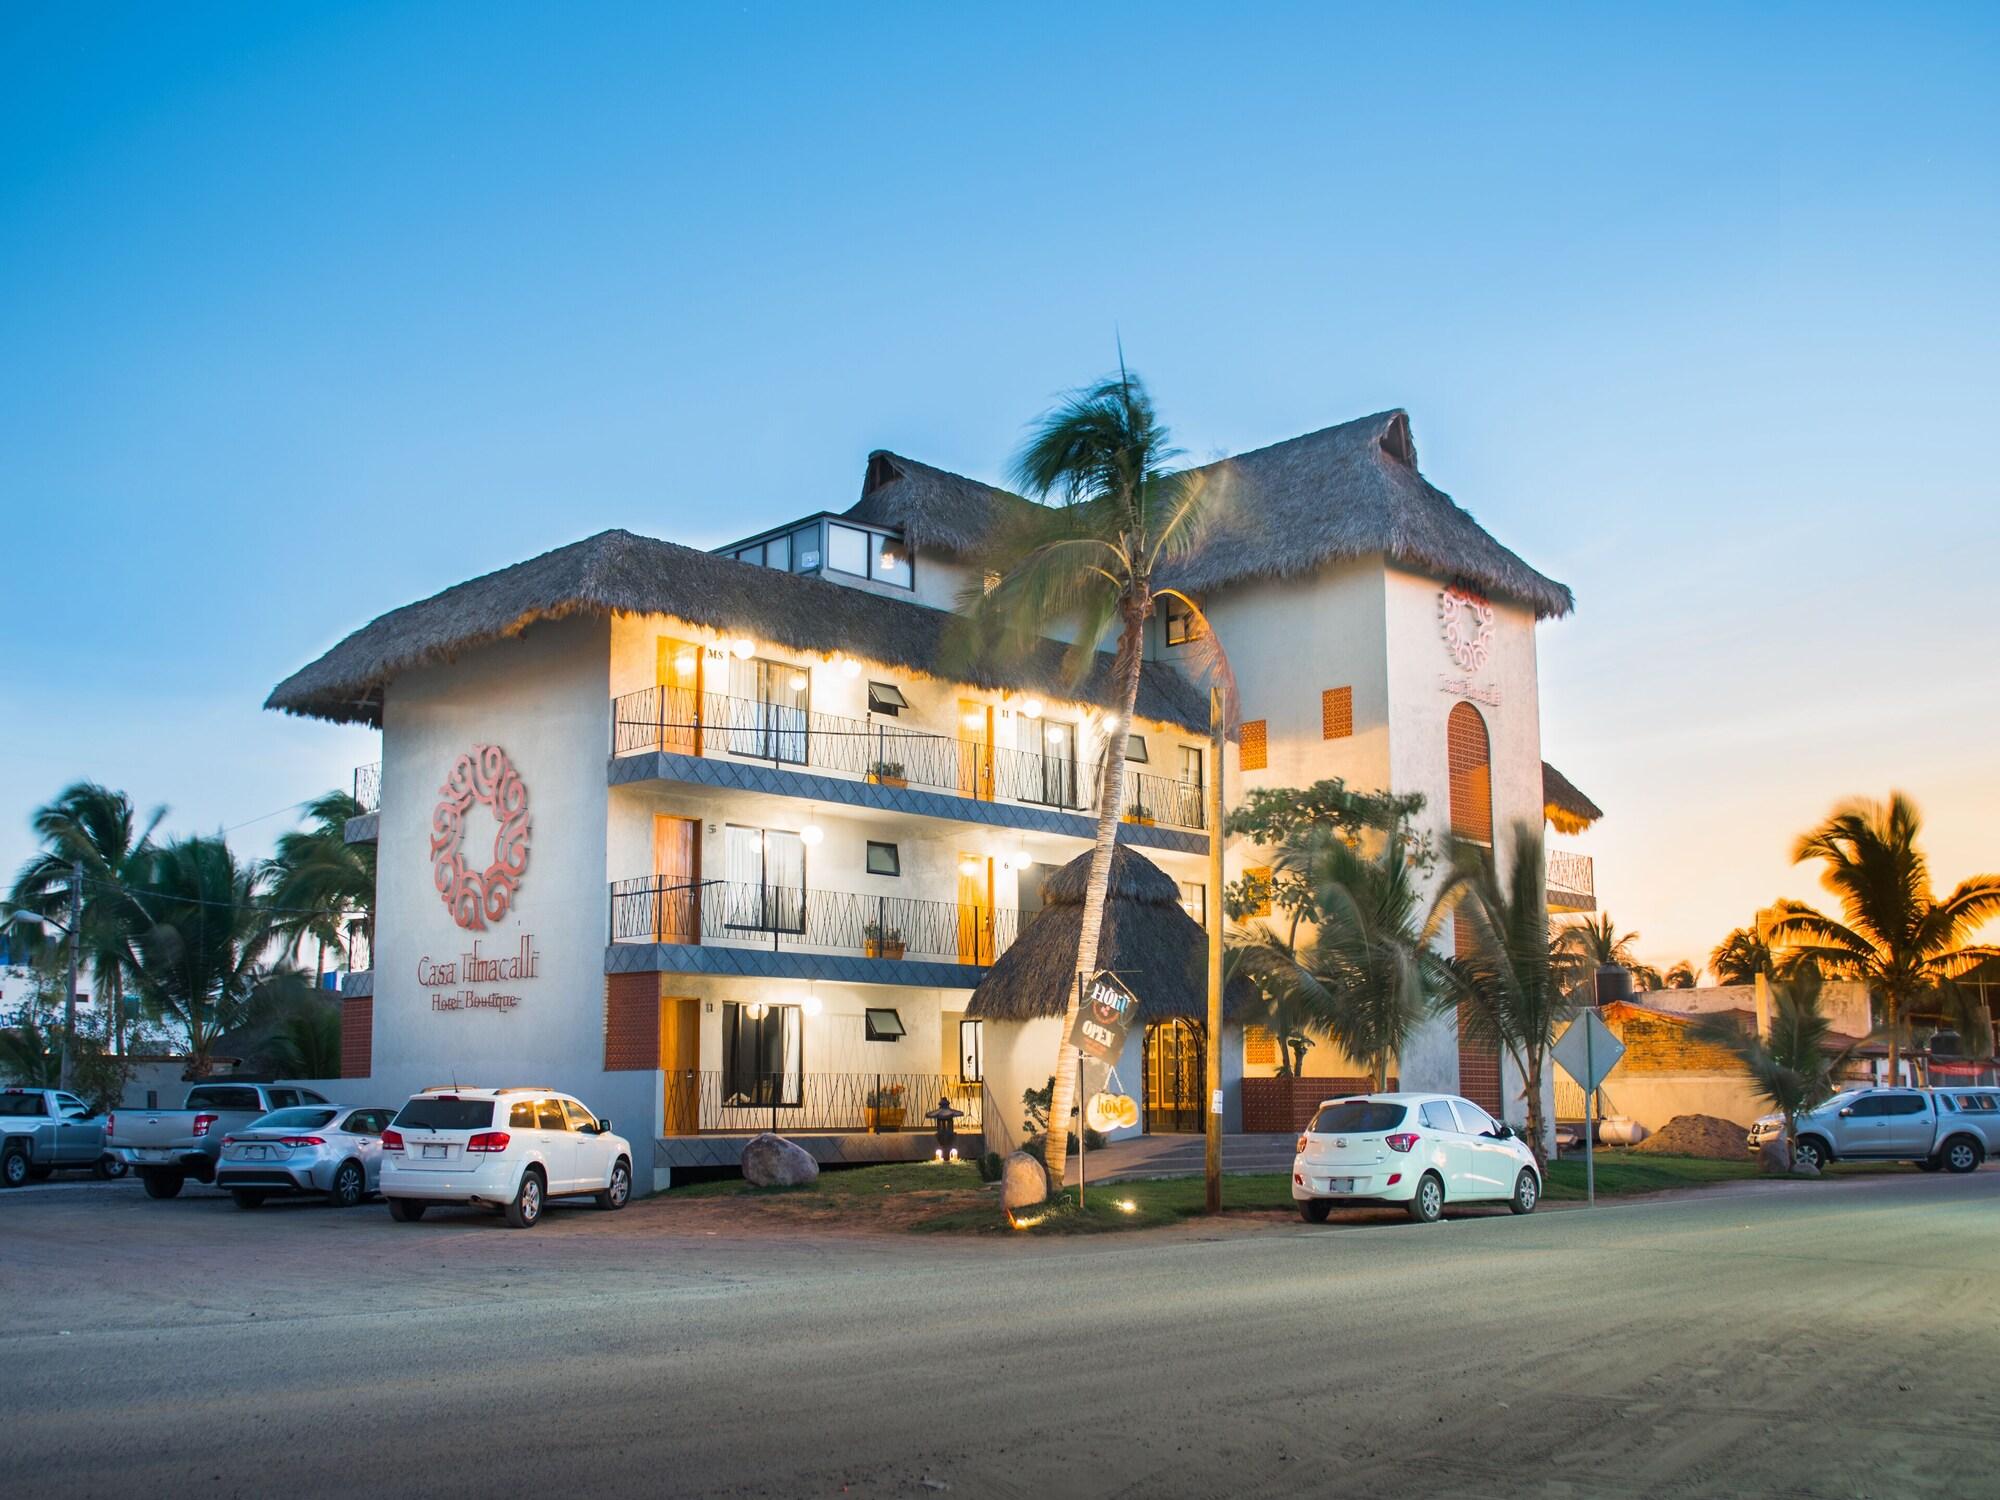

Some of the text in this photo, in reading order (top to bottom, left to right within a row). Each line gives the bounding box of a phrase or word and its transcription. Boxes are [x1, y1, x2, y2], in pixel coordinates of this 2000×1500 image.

[418, 956, 456, 986] Casa
[465, 990, 521, 1013] Boutique
[1082, 1020, 1115, 1048] OPEN
